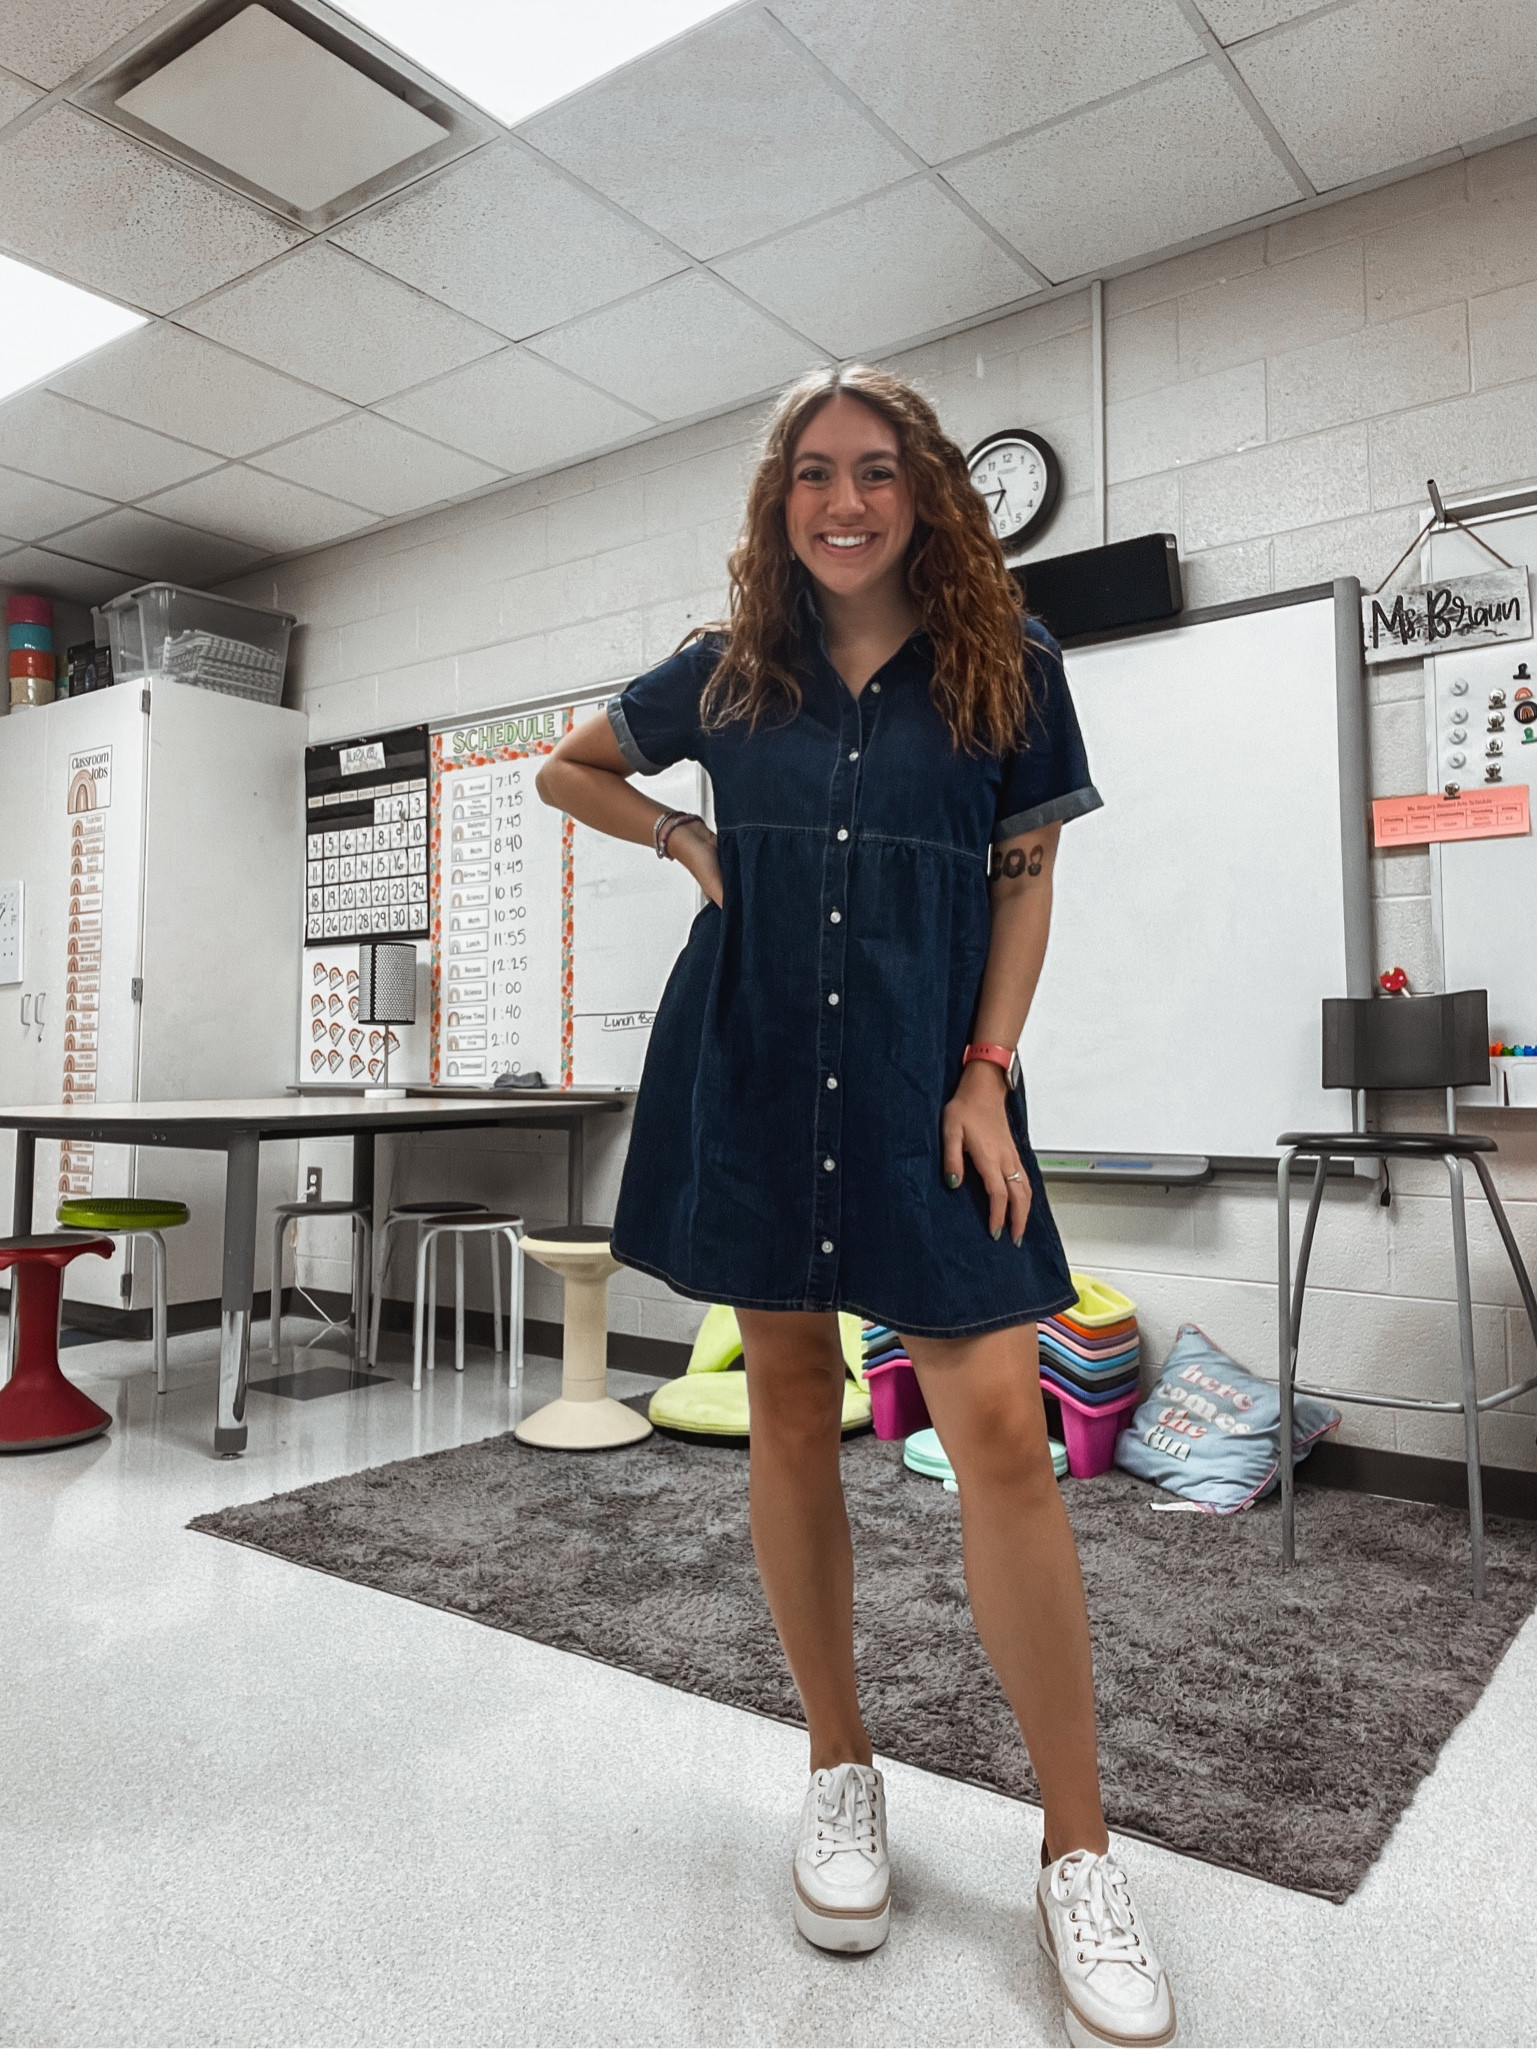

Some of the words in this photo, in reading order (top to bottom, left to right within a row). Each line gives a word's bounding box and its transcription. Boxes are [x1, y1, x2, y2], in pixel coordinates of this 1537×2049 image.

[1002, 453, 1013, 463] 12
[1020, 455, 1025, 464] 1
[1029, 464, 1036, 474] 2
[1032, 481, 1039, 491] 3
[1000, 520, 1006, 530] 6
[1015, 513, 1022, 523] 5
[452, 713, 556, 754] SCHEDULE
[72, 752, 109, 770] Classroom
[89, 767, 108, 781] Jobs
[381, 803, 385, 820] 1
[397, 800, 404, 817] 2
[414, 797, 421, 813] 3
[313, 840, 318, 853] 4
[328, 837, 334, 853] 5
[344, 835, 351, 850] 6
[362, 832, 368, 849] 7
[378, 830, 385, 846] 8
[396, 828, 402, 843] 9
[413, 823, 422, 841] 10
[313, 866, 318, 881] 11
[328, 863, 336, 879] 12
[343, 862, 351, 878] 13
[361, 860, 368, 875] 14
[377, 857, 386, 873] 15
[394, 854, 404, 871] 16
[413, 853, 422, 870] 17
[311, 892, 319, 908] 18
[328, 890, 336, 906] 19
[342, 887, 354, 905] 20
[359, 887, 368, 903] 21
[374, 885, 387, 901] 22
[392, 883, 405, 900] 23
[411, 881, 424, 898] 24
[311, 918, 321, 934] 25
[325, 916, 338, 933] 26
[342, 915, 353, 931] 27
[358, 913, 369, 930] 28
[374, 912, 387, 928] 29
[393, 908, 406, 926] 30
[414, 908, 423, 925] 31
[494, 929, 526, 946] 11:55
[492, 956, 528, 975] 12:25
[604, 1015, 635, 1028] Lunch
[1178, 1364, 1254, 1412] here
[1156, 1382, 1251, 1434] comes
[1157, 1406, 1208, 1439] the
[1142, 1424, 1191, 1462] fun
